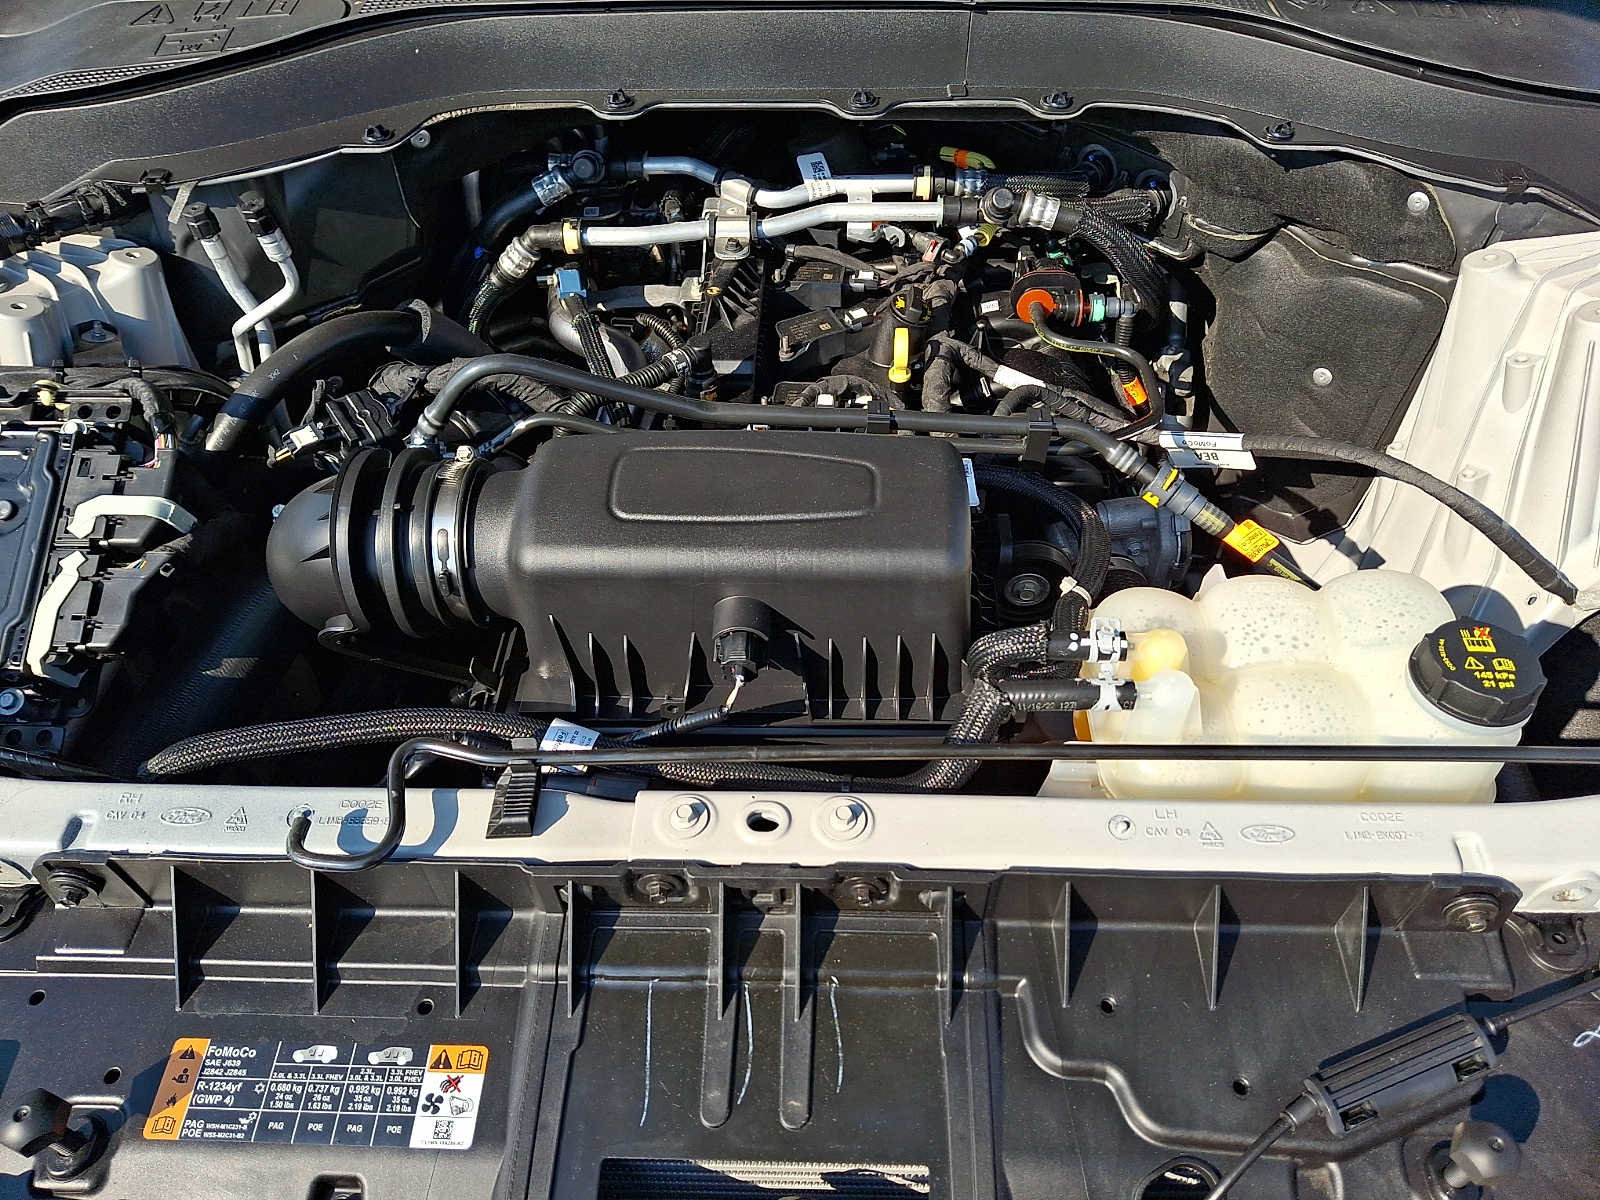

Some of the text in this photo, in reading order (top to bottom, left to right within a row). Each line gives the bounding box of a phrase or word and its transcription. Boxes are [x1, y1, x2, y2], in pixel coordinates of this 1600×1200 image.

[1181, 439, 1217, 448] FoMoCo
[1154, 807, 1178, 820] LH
[207, 1045, 257, 1058] FoMoCo
[204, 1058, 242, 1067] SAE J639
[325, 1073, 344, 1081] FHEV
[197, 1080, 244, 1094] R-1234yf
[270, 1082, 303, 1095] 0.680 kg
[308, 1084, 341, 1096] 0.737 kg
[348, 1085, 381, 1096] 0.992 kg
[386, 1086, 419, 1098] 0.992 kg
[192, 1093, 235, 1107] (GWP 4)
[284, 1101, 295, 1109] lbs
[322, 1102, 333, 1110] lbs
[363, 1103, 374, 1111] lbs
[401, 1104, 412, 1113] lbs
[184, 1119, 205, 1129] PAG
[267, 1121, 285, 1130] PAG
[307, 1123, 324, 1132] POE
[346, 1124, 363, 1133] PAG
[181, 1128, 203, 1138] POE
[386, 1125, 403, 1135] POE
